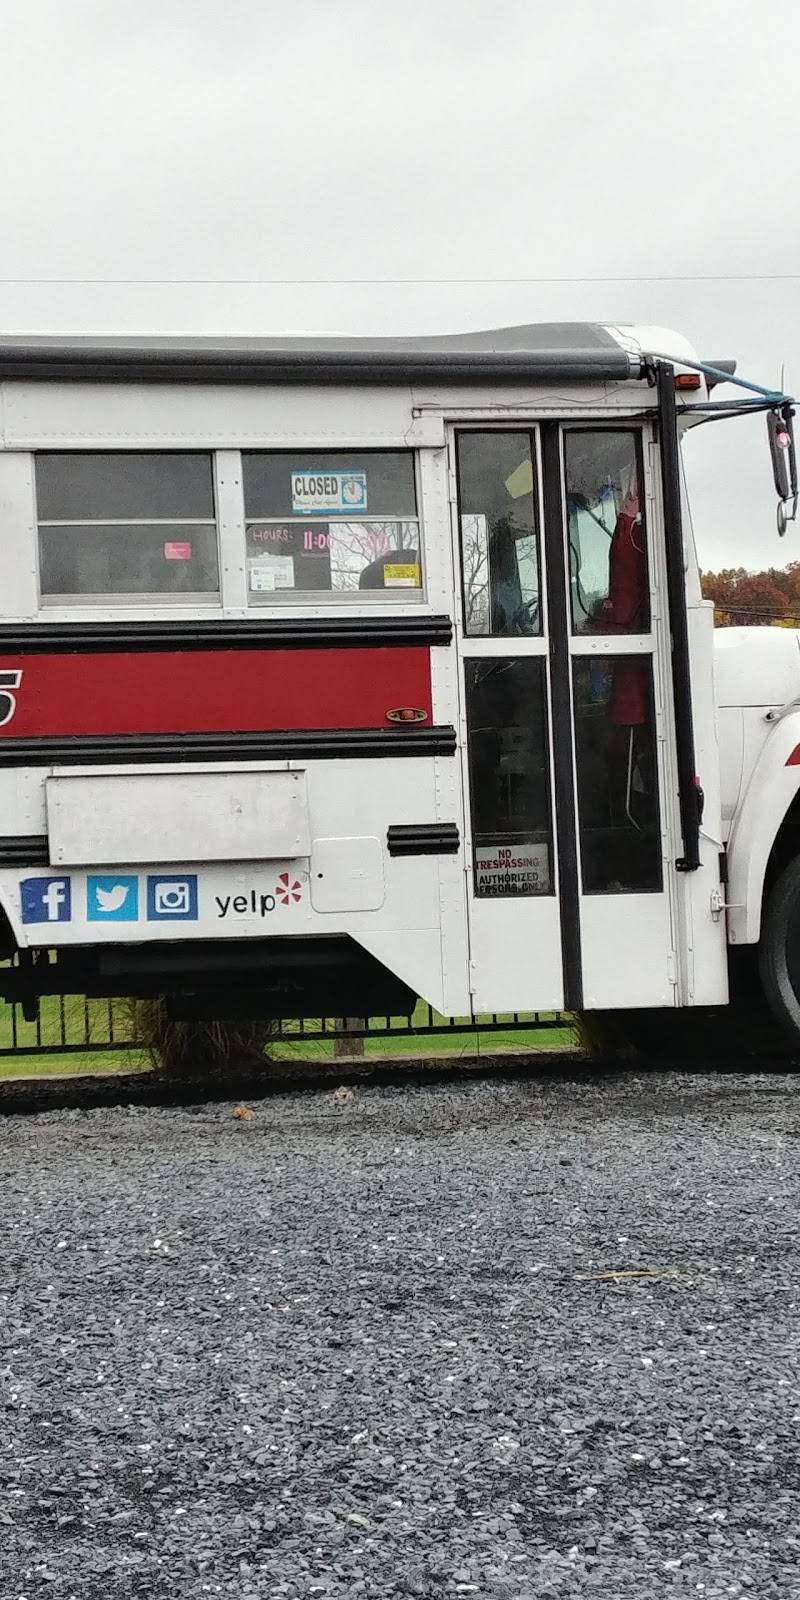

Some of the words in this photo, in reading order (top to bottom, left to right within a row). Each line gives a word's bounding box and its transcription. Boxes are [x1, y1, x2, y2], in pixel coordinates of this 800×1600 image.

[295, 477, 339, 496] CLOSED
[498, 848, 512, 859] NO
[475, 856, 541, 870] TRESPASSING
[479, 871, 539, 885] AUTHORIZED
[215, 889, 276, 917] yelp
